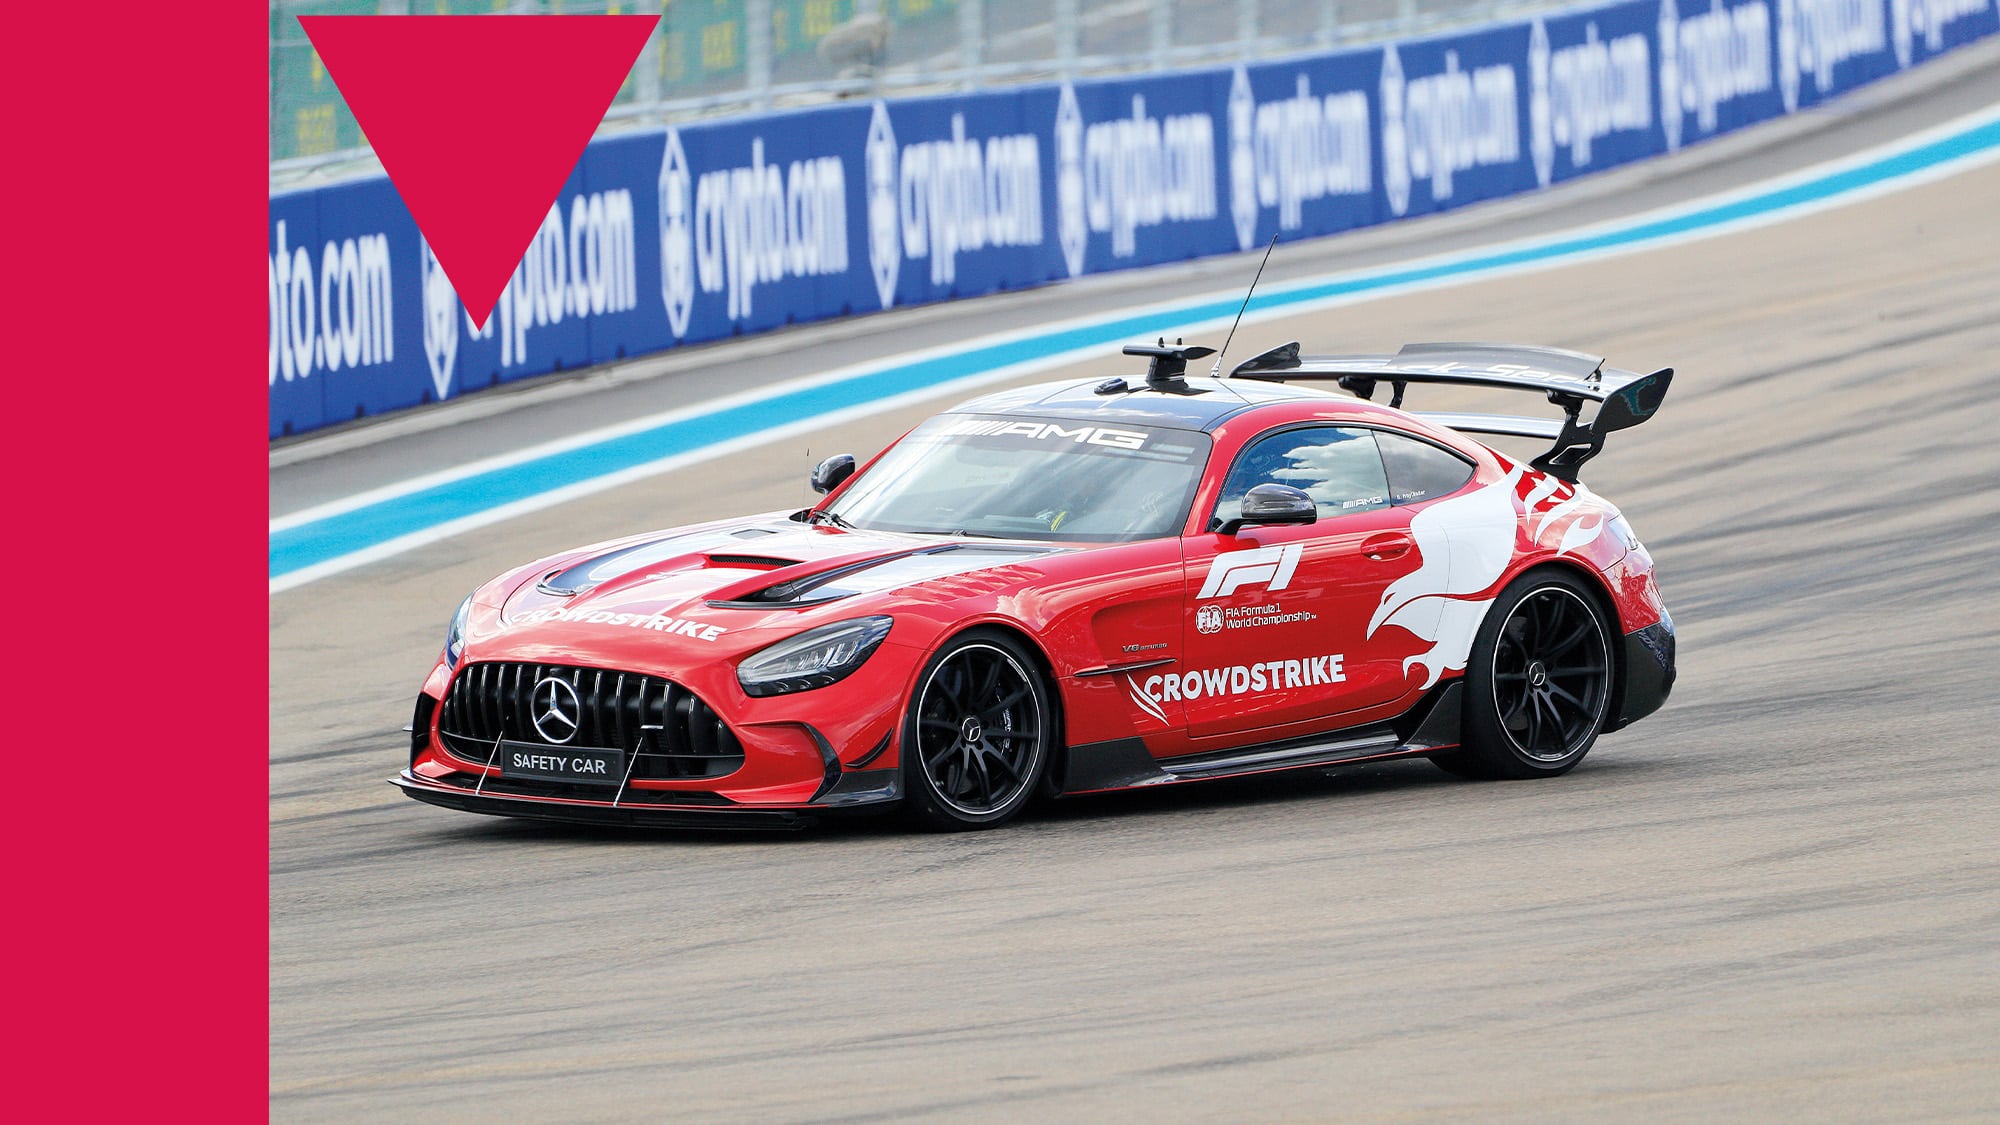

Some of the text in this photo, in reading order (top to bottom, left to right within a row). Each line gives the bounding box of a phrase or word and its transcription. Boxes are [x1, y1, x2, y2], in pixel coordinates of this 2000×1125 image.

[901, 111, 1043, 286] crypto.com
[695, 136, 849, 321] crypto.com
[991, 421, 1149, 450] AMG
[1196, 543, 1305, 600] F1
[511, 607, 728, 642] CROWDSTRIKE
[1225, 602, 1282, 618] FIA Formula 1
[1226, 617, 1251, 629] World
[1252, 610, 1311, 627] Championship
[1143, 653, 1347, 703] CROWDSTRIKE
[513, 752, 607, 775] SAFETY CAR
